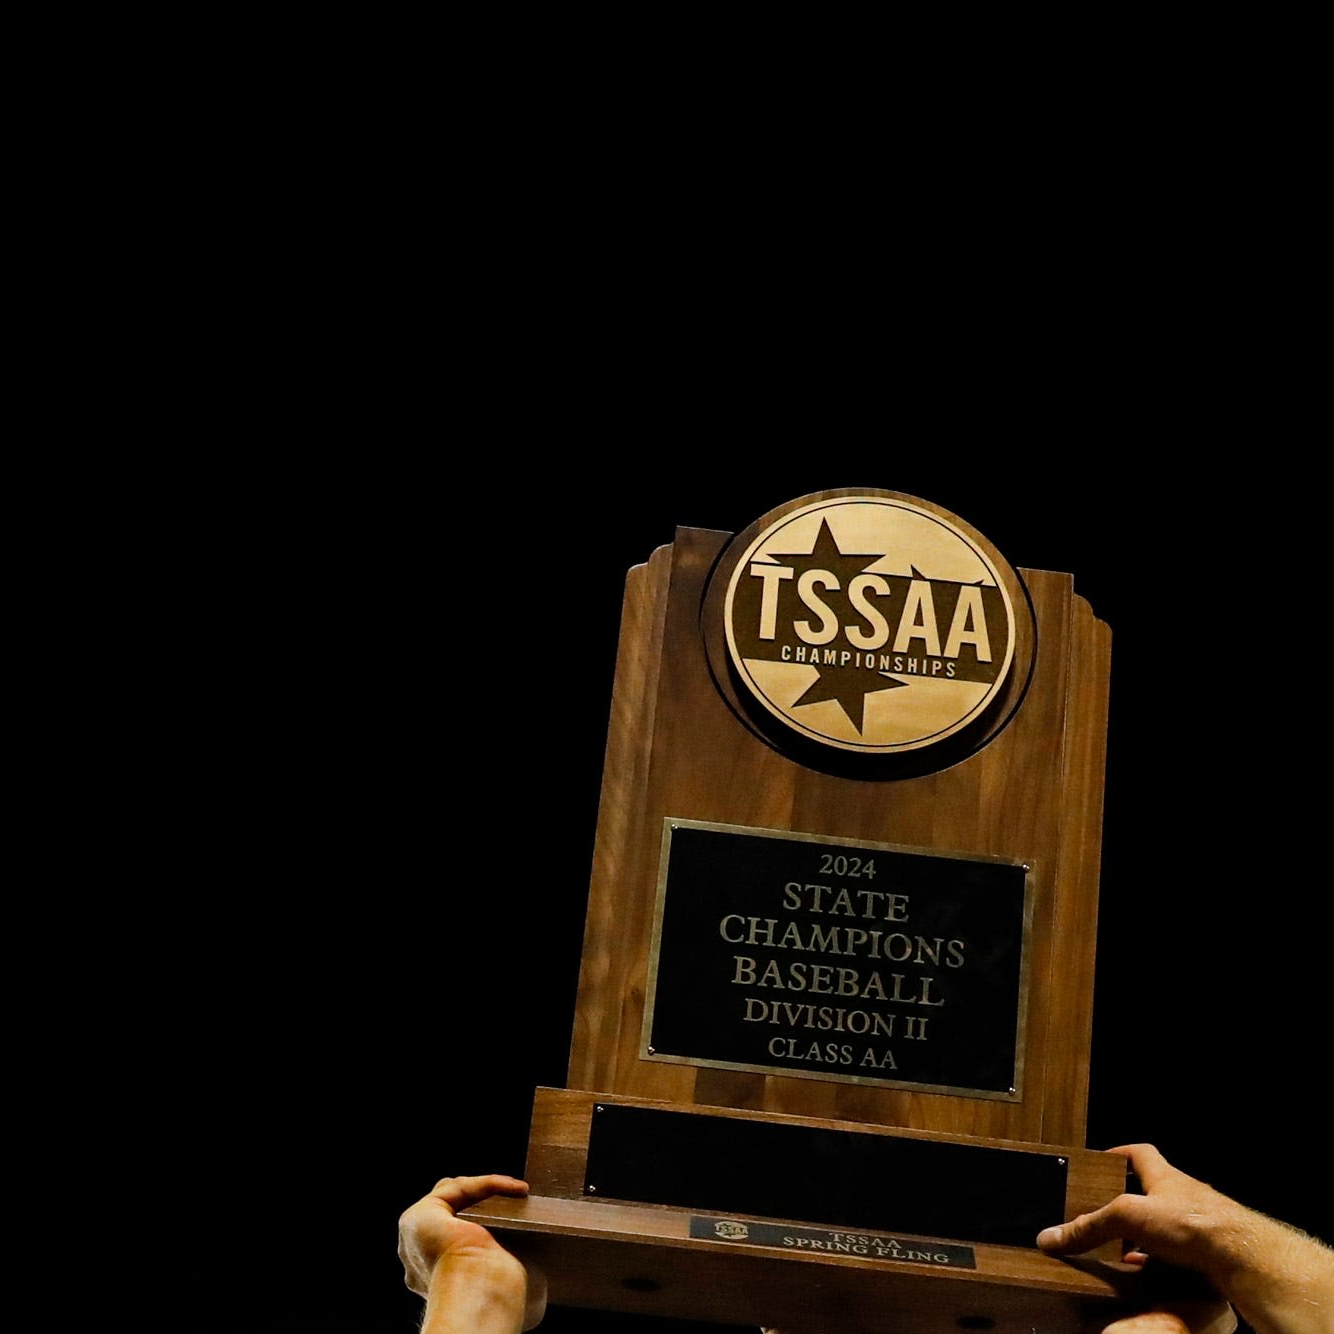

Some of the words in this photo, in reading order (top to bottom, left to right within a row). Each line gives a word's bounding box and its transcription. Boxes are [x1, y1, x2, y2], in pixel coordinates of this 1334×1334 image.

[750, 563, 993, 662] TSSAA
[781, 645, 956, 677] CHAMPIONSHIPS
[819, 854, 877, 880] 2024
[782, 882, 910, 923] STATE
[719, 914, 965, 969] CHAMPIONS
[731, 956, 945, 1007] BASEBALL
[743, 998, 896, 1038] DIVISION
[905, 1016, 929, 1041] II
[768, 1037, 853, 1065] CLASS
[860, 1047, 898, 1071] AA
[783, 1236, 868, 1254] SPRING
[876, 1247, 950, 1264] FLING
[829, 1232, 902, 1248] TSSAA
